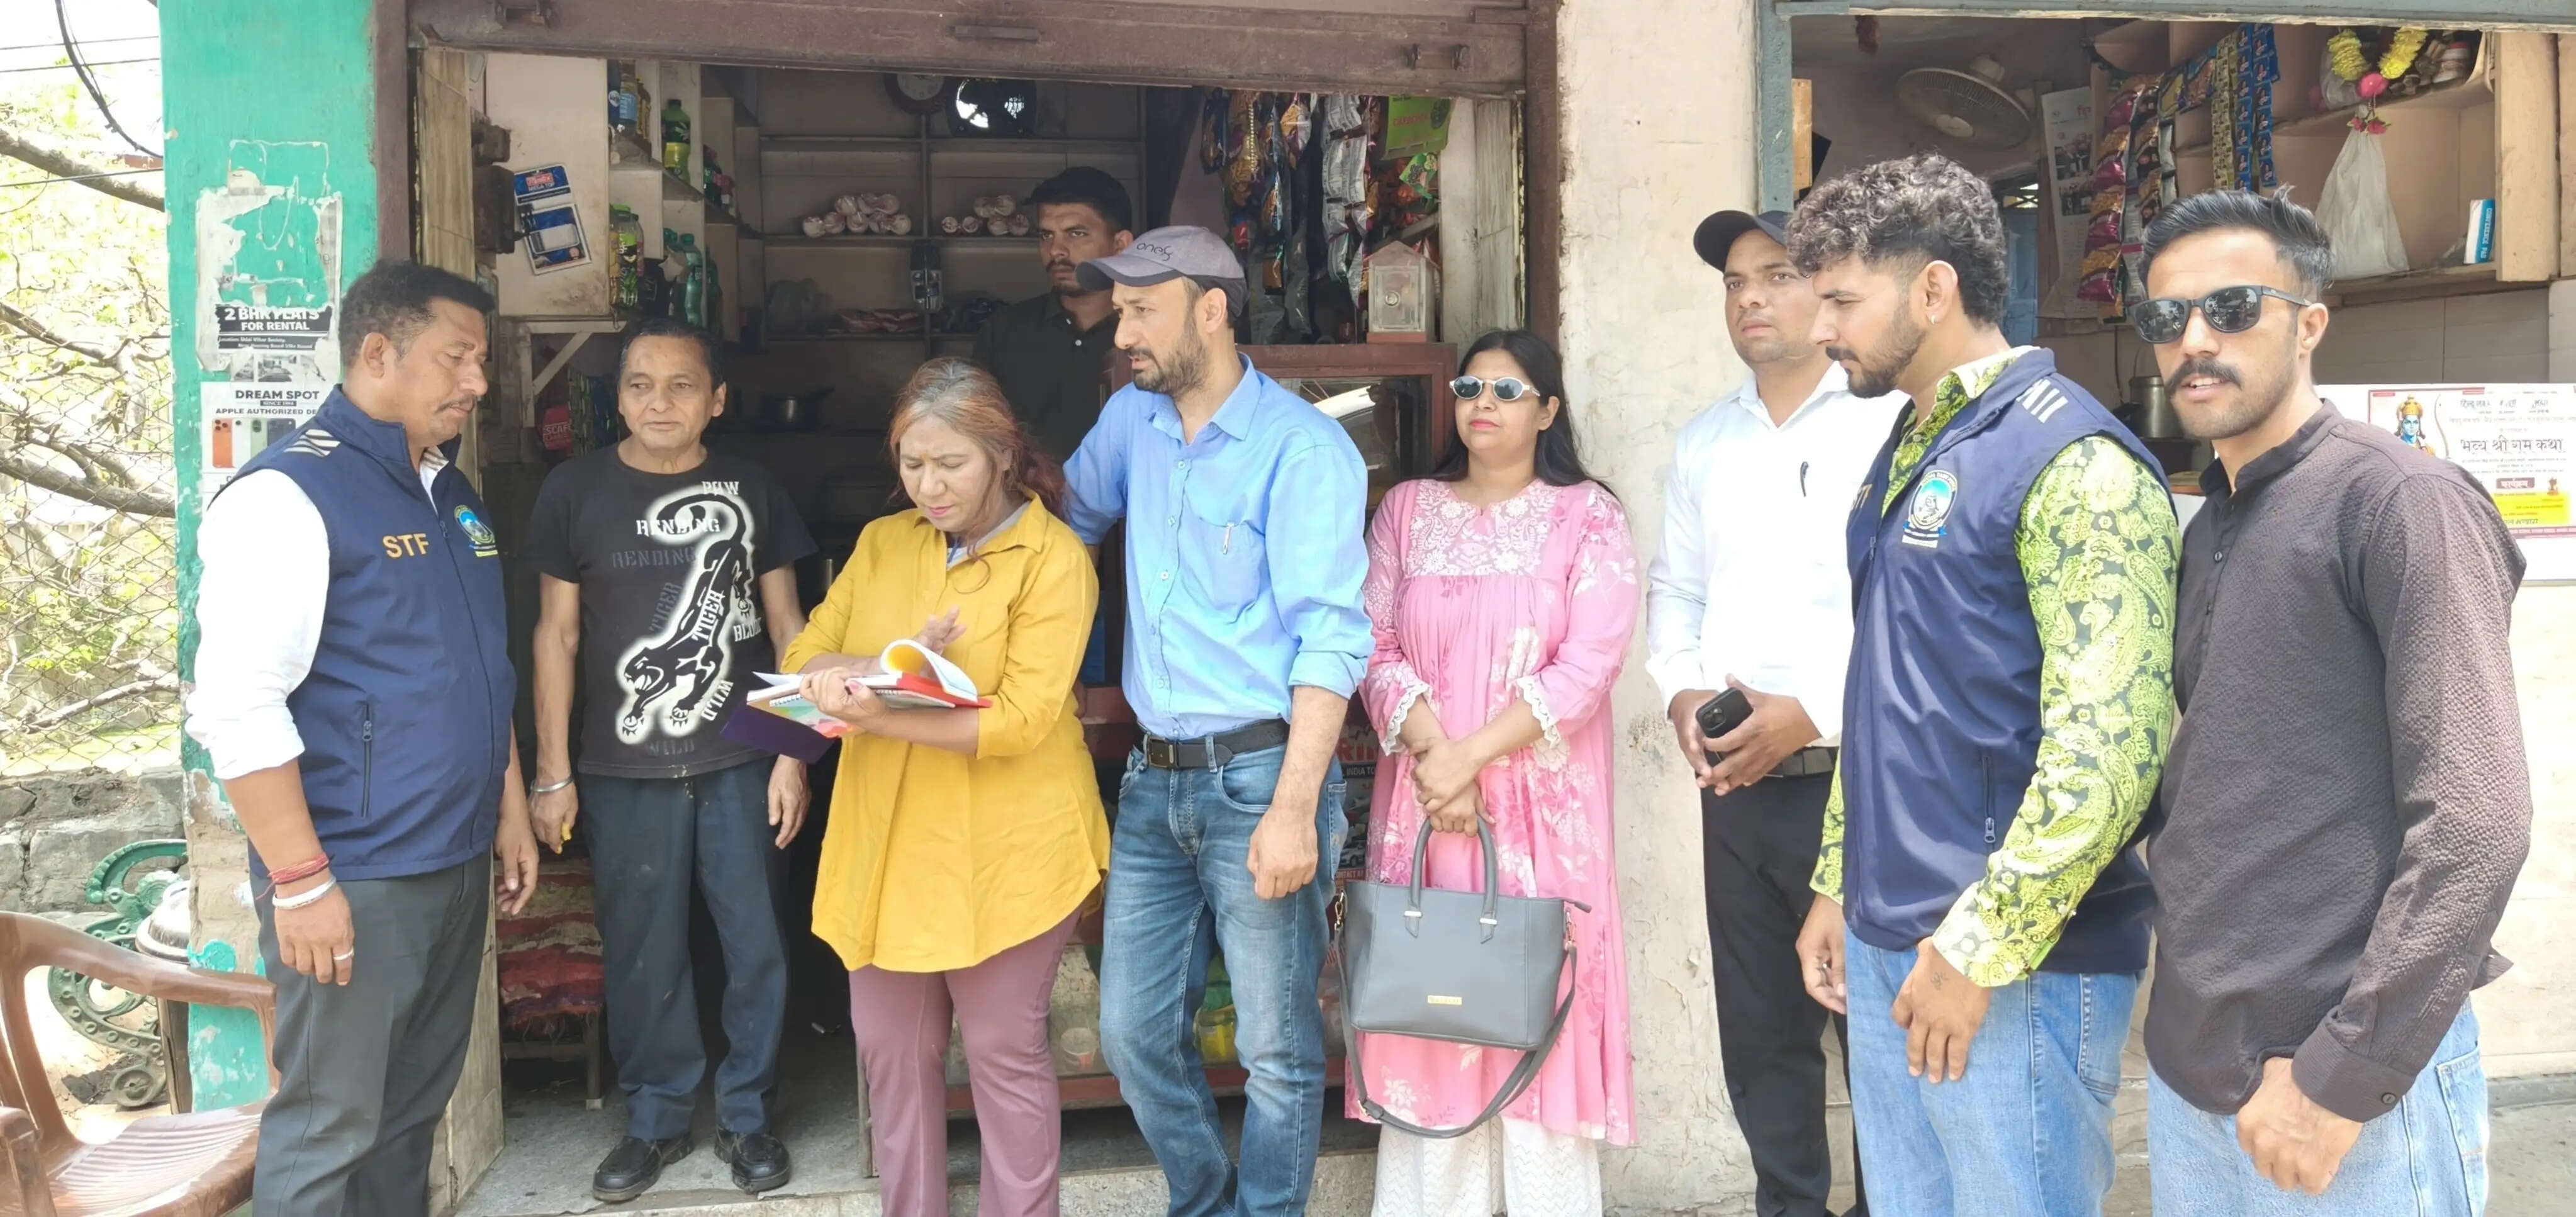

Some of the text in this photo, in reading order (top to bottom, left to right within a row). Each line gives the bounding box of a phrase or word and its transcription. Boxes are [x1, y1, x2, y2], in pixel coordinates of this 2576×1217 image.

[224, 307, 237, 321] 2
[241, 322, 310, 331] FOR RENTAL
[235, 390, 320, 400] DREAM SPOT
[2460, 439, 2488, 452] भव्य
[2492, 434, 2509, 452] श्री
[2535, 438, 2564, 451] कथा
[382, 533, 430, 559] STF
[692, 590, 725, 641] TIGER
[700, 680, 734, 722] WILD
[1347, 766, 1375, 776] INDIA TO
